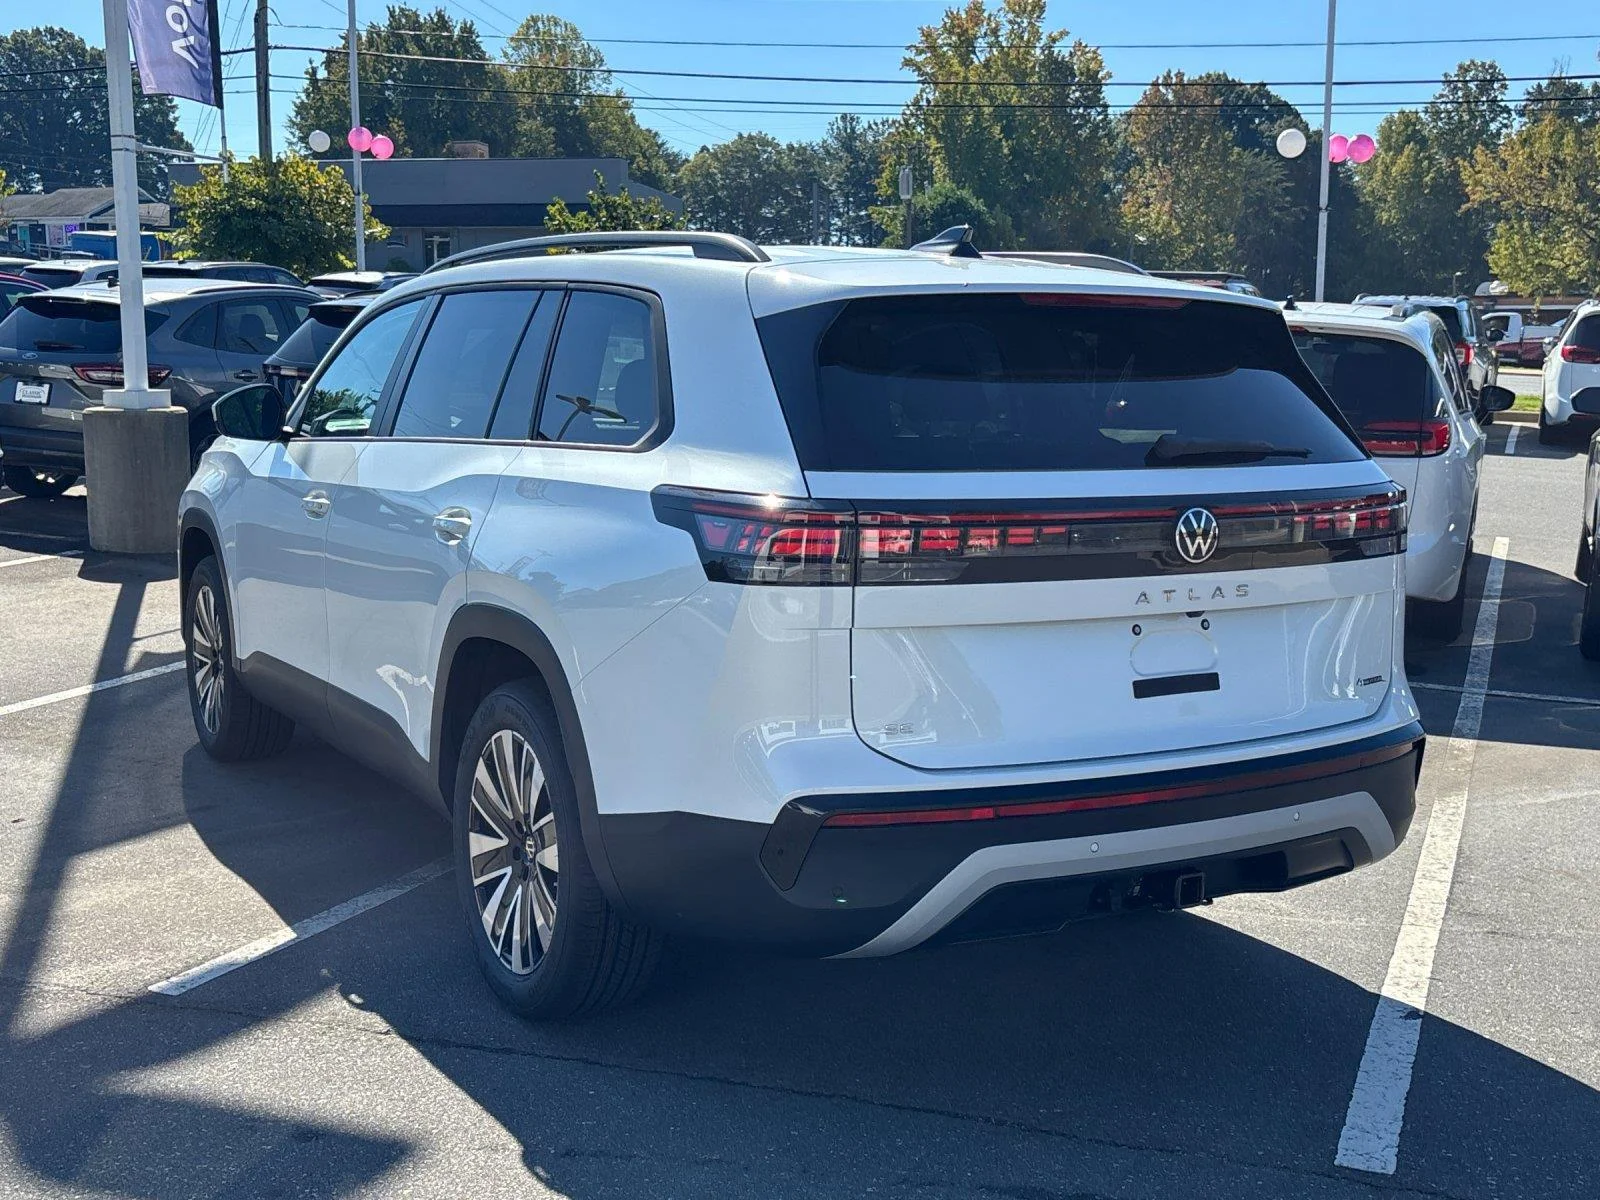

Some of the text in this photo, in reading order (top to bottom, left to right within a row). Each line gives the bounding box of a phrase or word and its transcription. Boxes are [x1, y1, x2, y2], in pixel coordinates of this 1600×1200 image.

[1178, 510, 1217, 560] VW
[1135, 584, 1249, 605] ATLAS
[885, 723, 914, 735] SE
